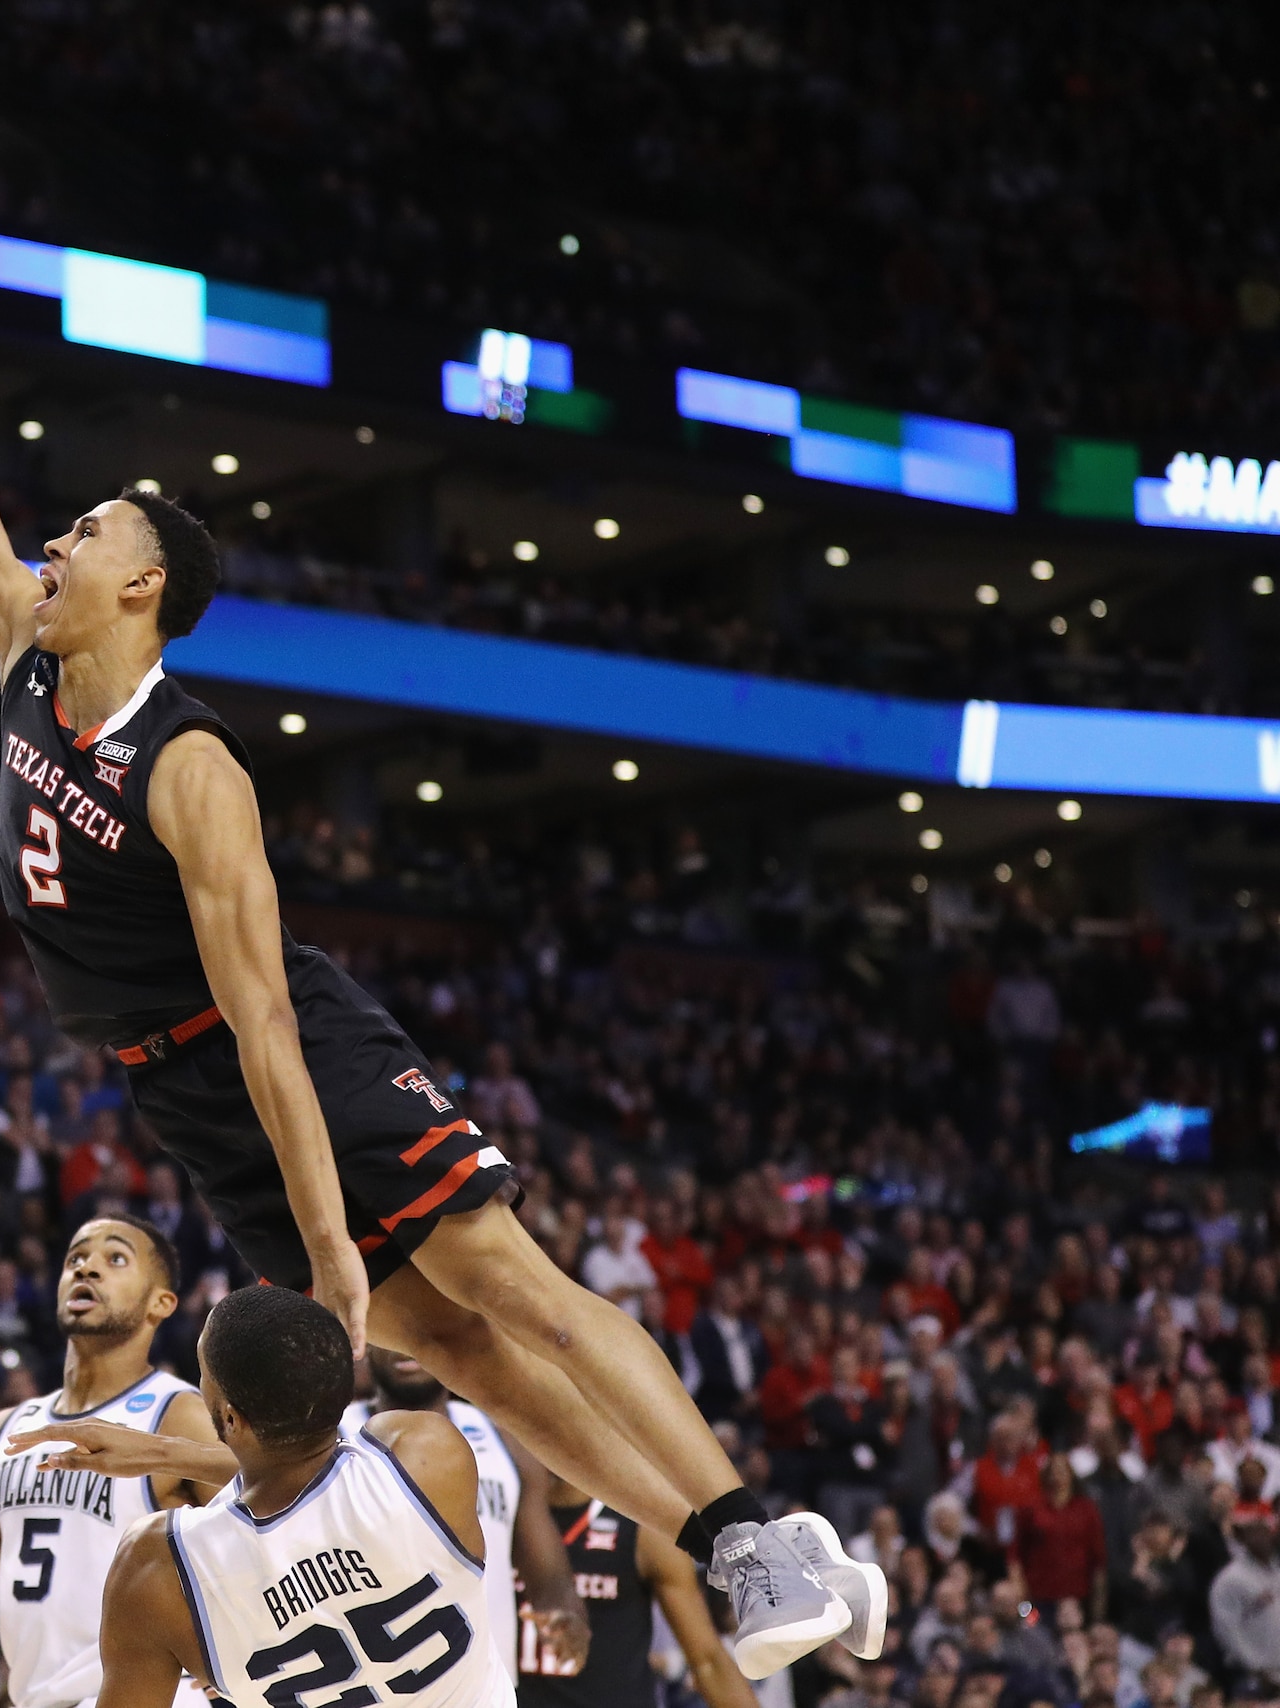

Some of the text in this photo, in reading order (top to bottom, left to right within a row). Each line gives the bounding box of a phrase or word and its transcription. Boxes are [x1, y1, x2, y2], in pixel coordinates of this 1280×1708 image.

[5, 732, 127, 852] TEXAS TECH
[99, 742, 134, 761] CORKY
[19, 803, 67, 909] 2
[12, 1517, 61, 1602] 5
[262, 1548, 383, 1631] BRIDGES
[245, 1571, 475, 1708] 25
